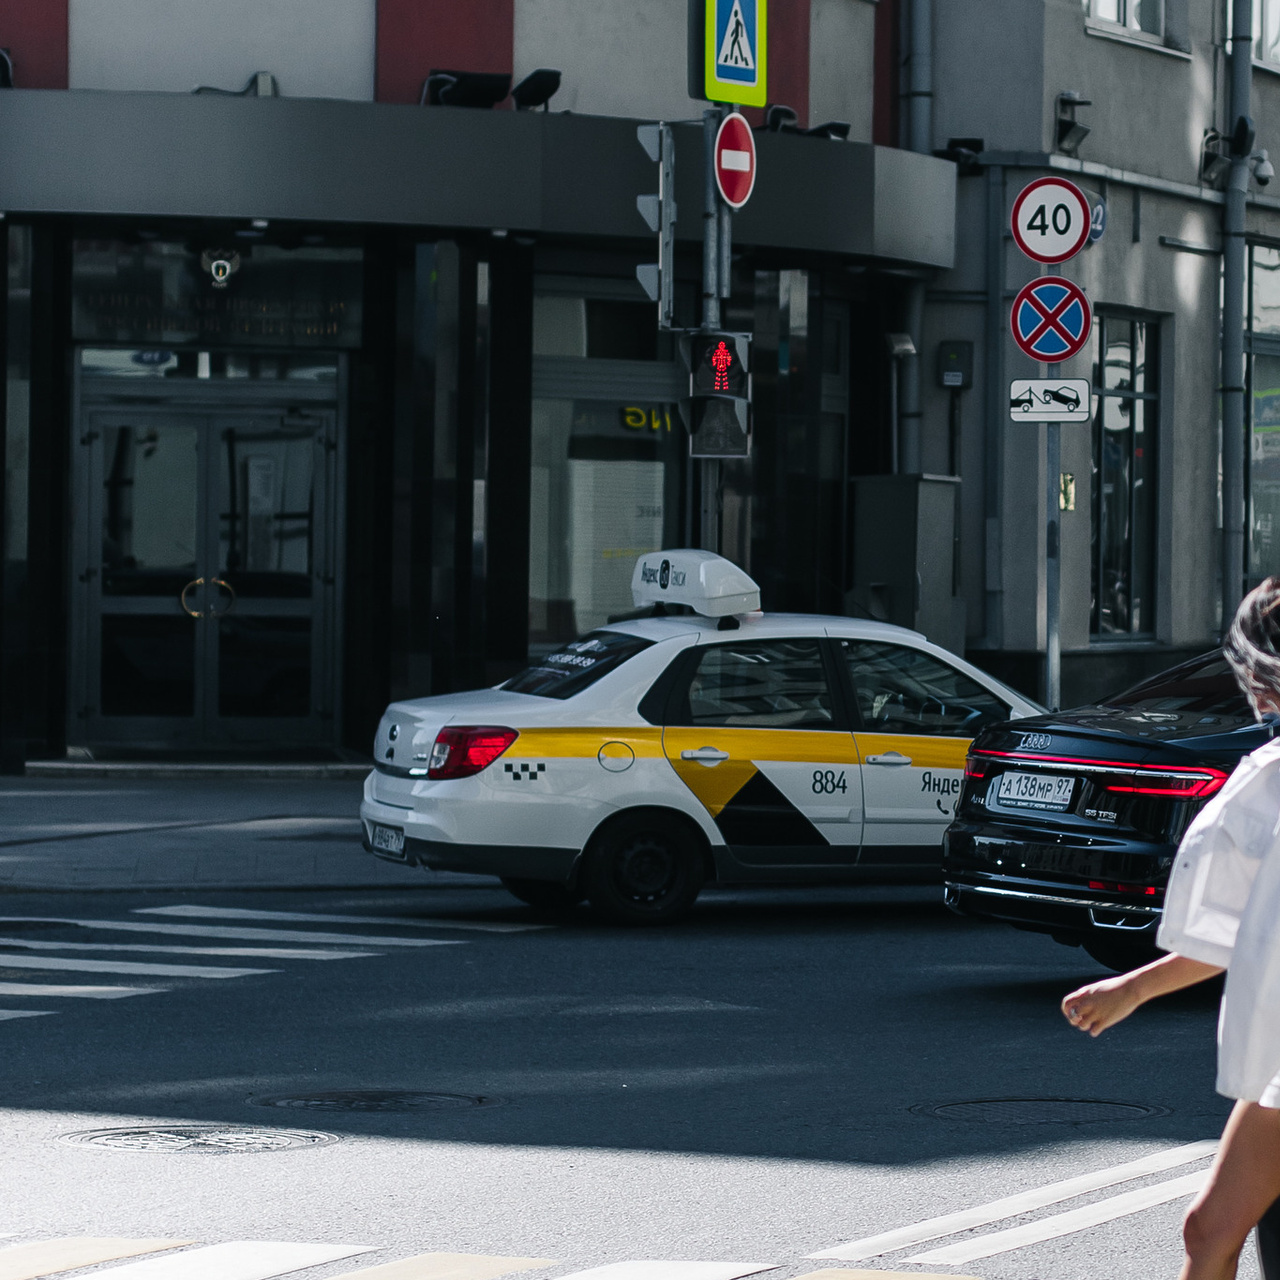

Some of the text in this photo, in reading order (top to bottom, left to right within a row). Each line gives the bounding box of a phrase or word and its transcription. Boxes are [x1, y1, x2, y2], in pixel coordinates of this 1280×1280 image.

[1026, 203, 1071, 236] 40
[812, 770, 848, 794] 884
[921, 771, 964, 795] Янде
[1057, 778, 1070, 795] 97
